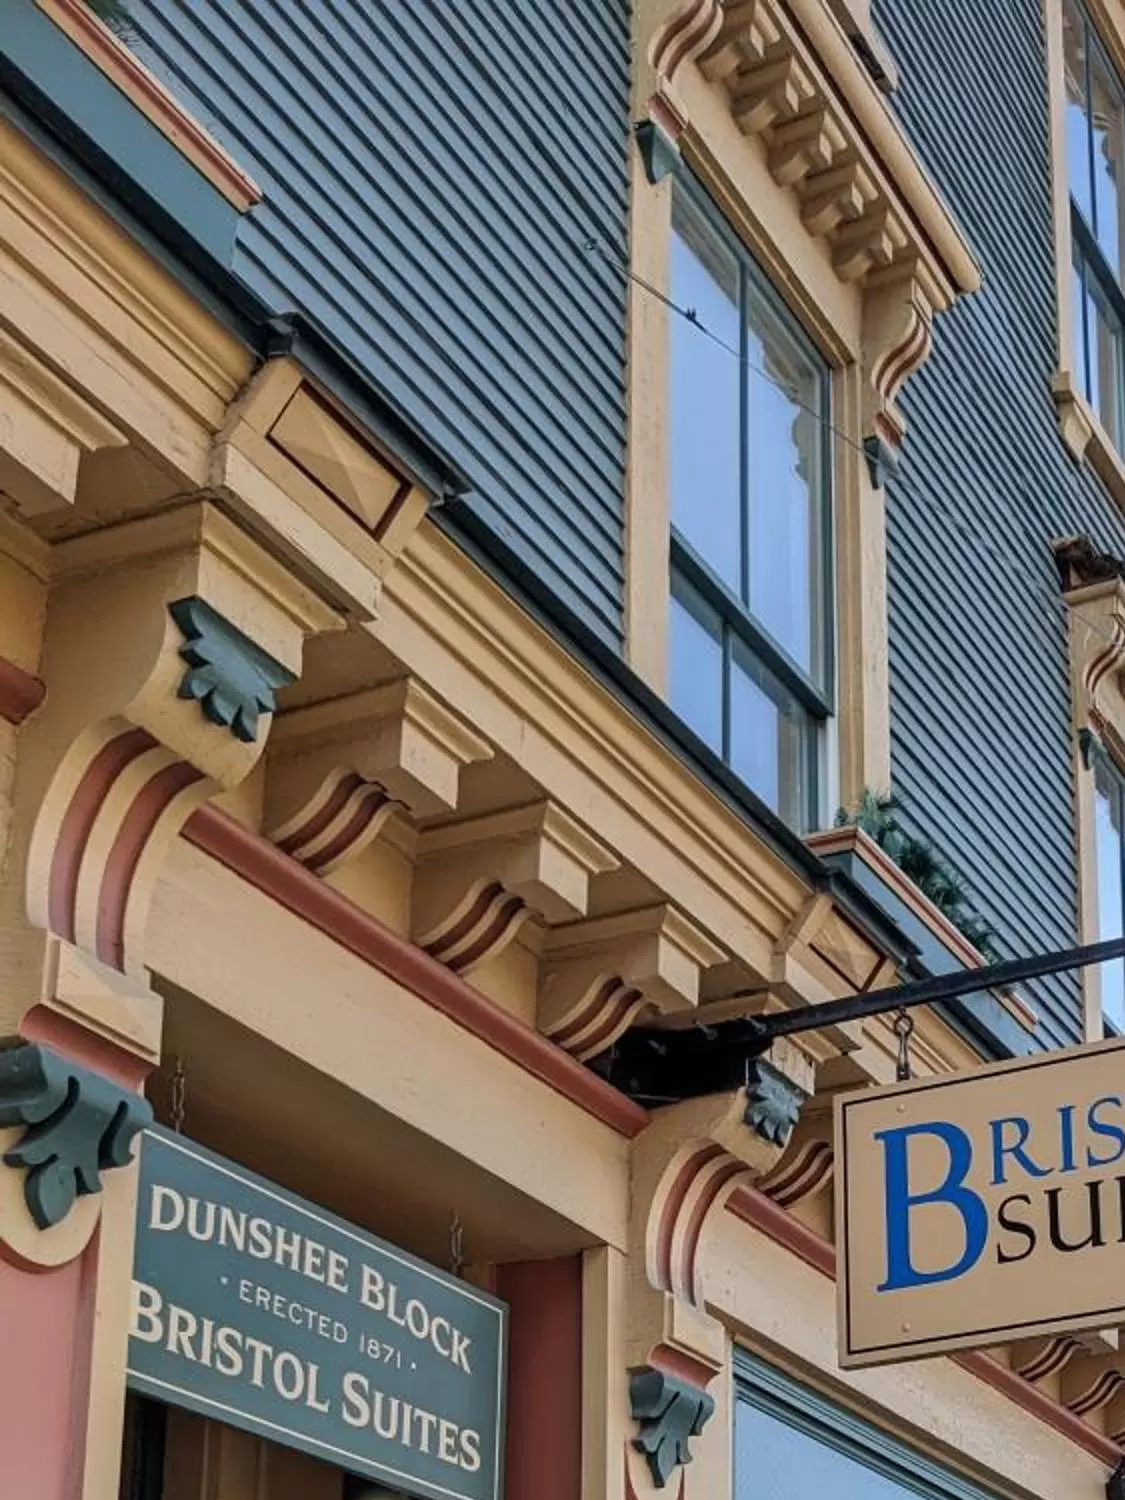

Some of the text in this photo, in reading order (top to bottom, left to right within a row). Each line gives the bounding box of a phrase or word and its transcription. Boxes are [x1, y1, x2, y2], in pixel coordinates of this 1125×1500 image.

[150, 1184, 473, 1374] DUNSHEE BLOCK
[239, 1280, 401, 1369] ERECTED 1871
[129, 1280, 482, 1473] BRISTOL SUITES
